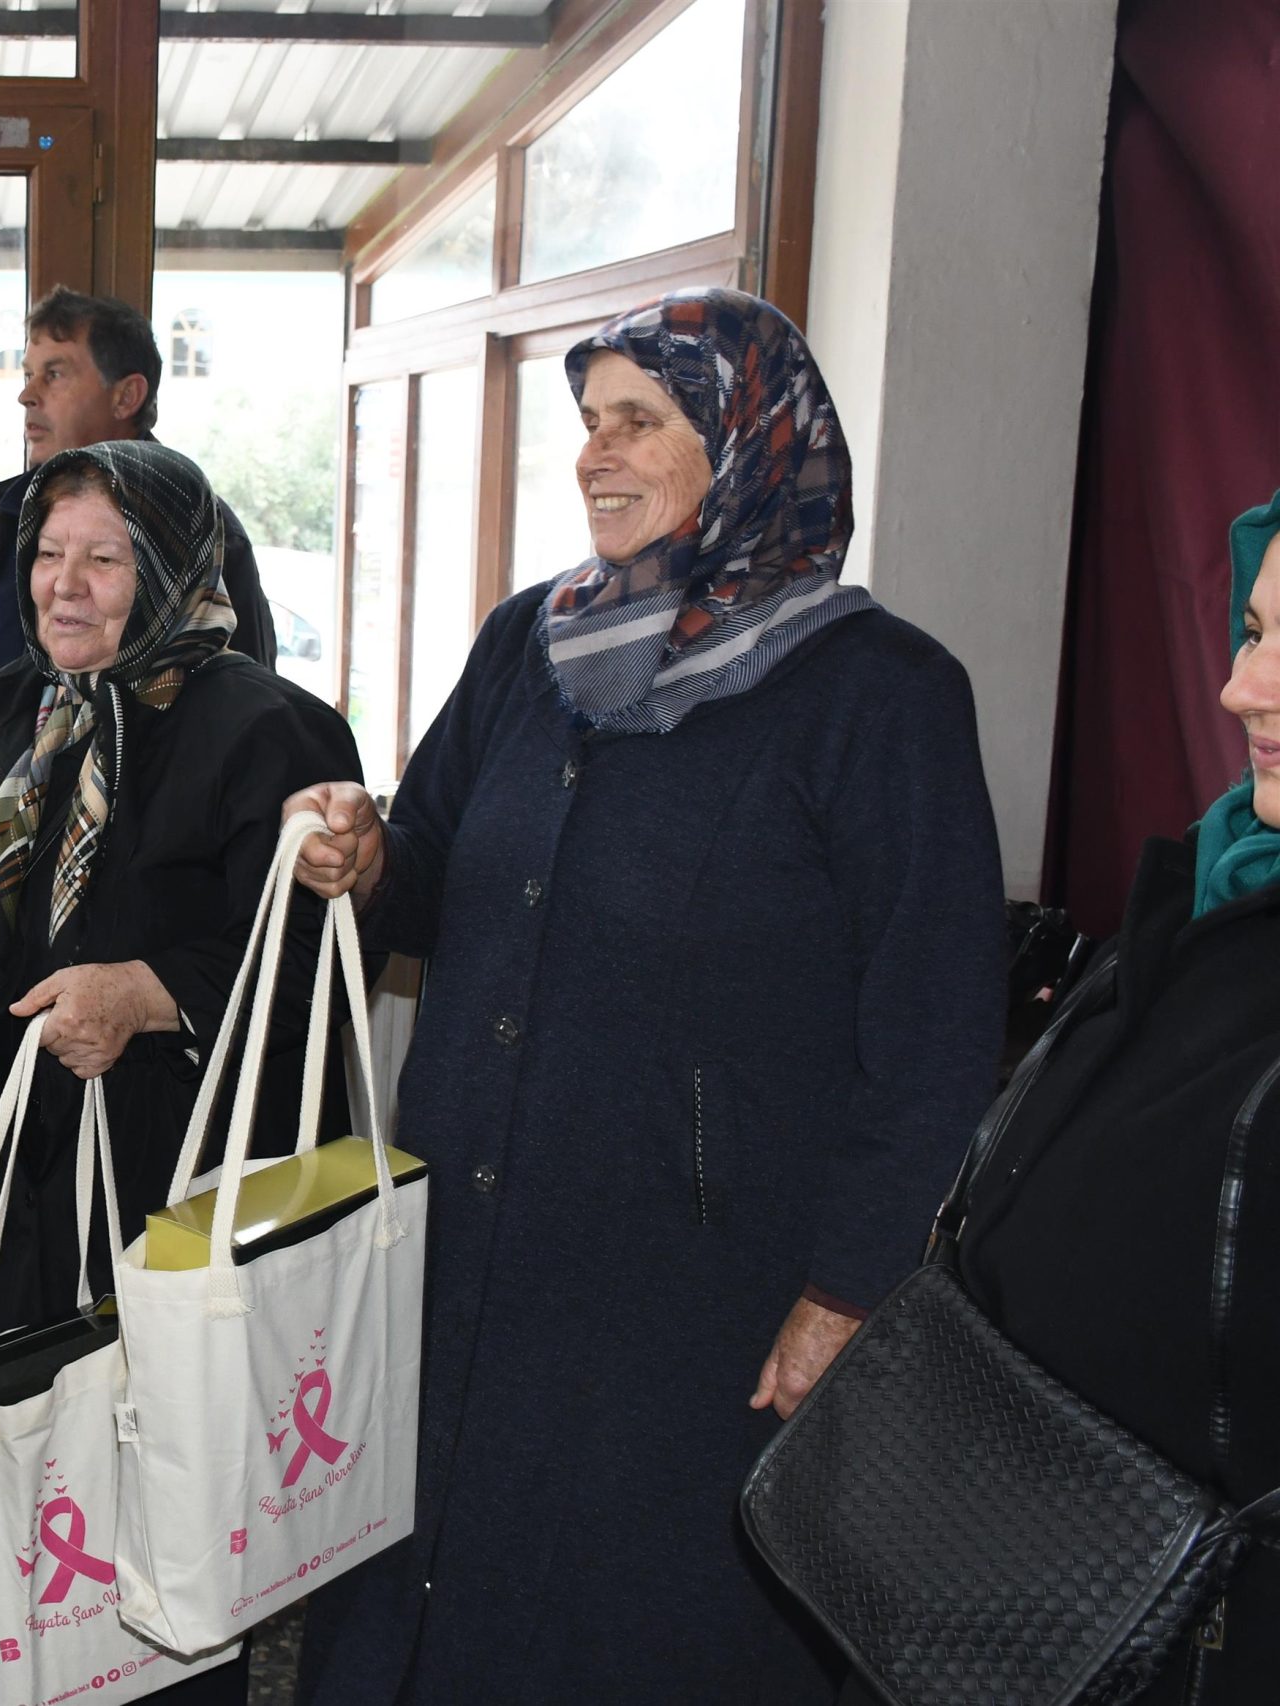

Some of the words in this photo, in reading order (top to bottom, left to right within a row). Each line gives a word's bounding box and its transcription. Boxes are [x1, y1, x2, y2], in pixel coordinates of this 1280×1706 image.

[258, 1495, 297, 1524] Hayata
[299, 1487, 325, 1511] Şans
[324, 1441, 367, 1487] Verelim
[72, 1604, 105, 1627] Şans
